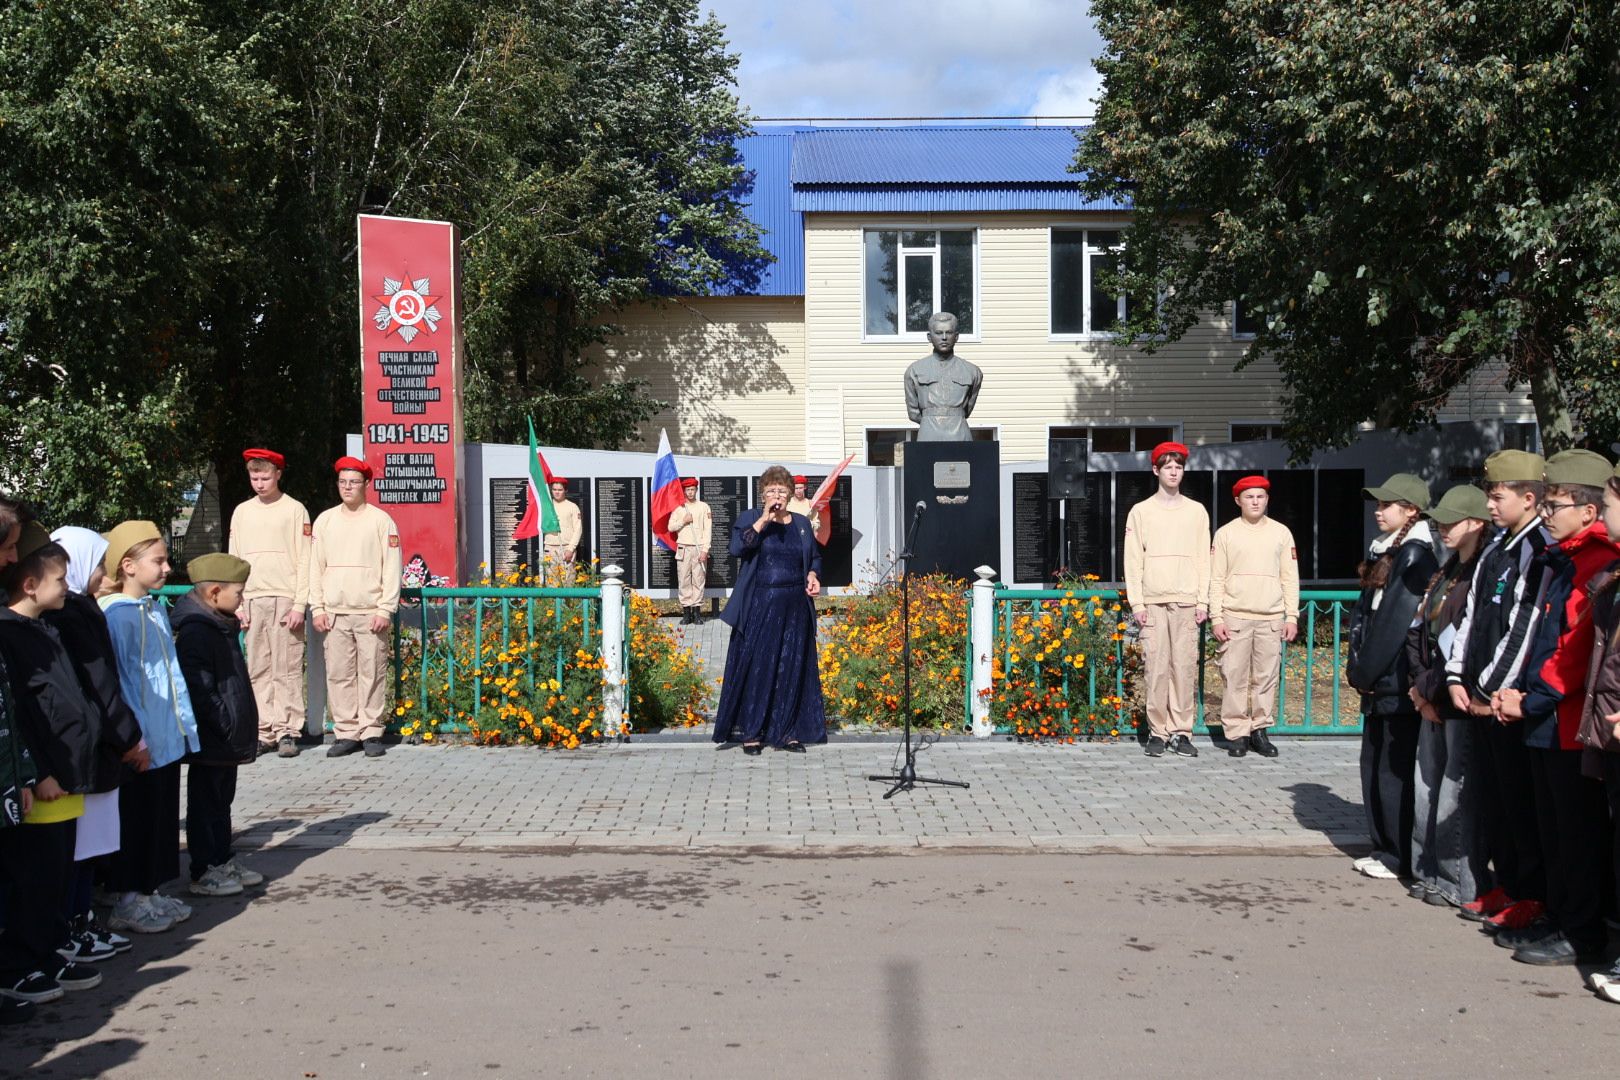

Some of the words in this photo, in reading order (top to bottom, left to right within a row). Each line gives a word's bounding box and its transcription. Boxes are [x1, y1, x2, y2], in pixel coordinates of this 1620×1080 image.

[379, 352, 409, 364] ВЕЧНАЯ
[412, 352, 438, 363] СЛАВА
[383, 365, 434, 376] УЧАСТНИКАМ
[391, 377, 426, 388] ВЕЛИКОЙ
[378, 389, 440, 401] ОТЕЧЕСТВЕННОЙ
[393, 402, 425, 413] ВОЙНЫ!
[369, 424, 449, 443] 1941-1945
[386, 454, 406, 465] БӨЕК
[409, 454, 434, 465] ВАТАН
[384, 466, 436, 477] СУГЫШЫНДА
[374, 479, 446, 490] КАТНАШУЧЫЛАРГА
[422, 492, 441, 502] ДАН!
